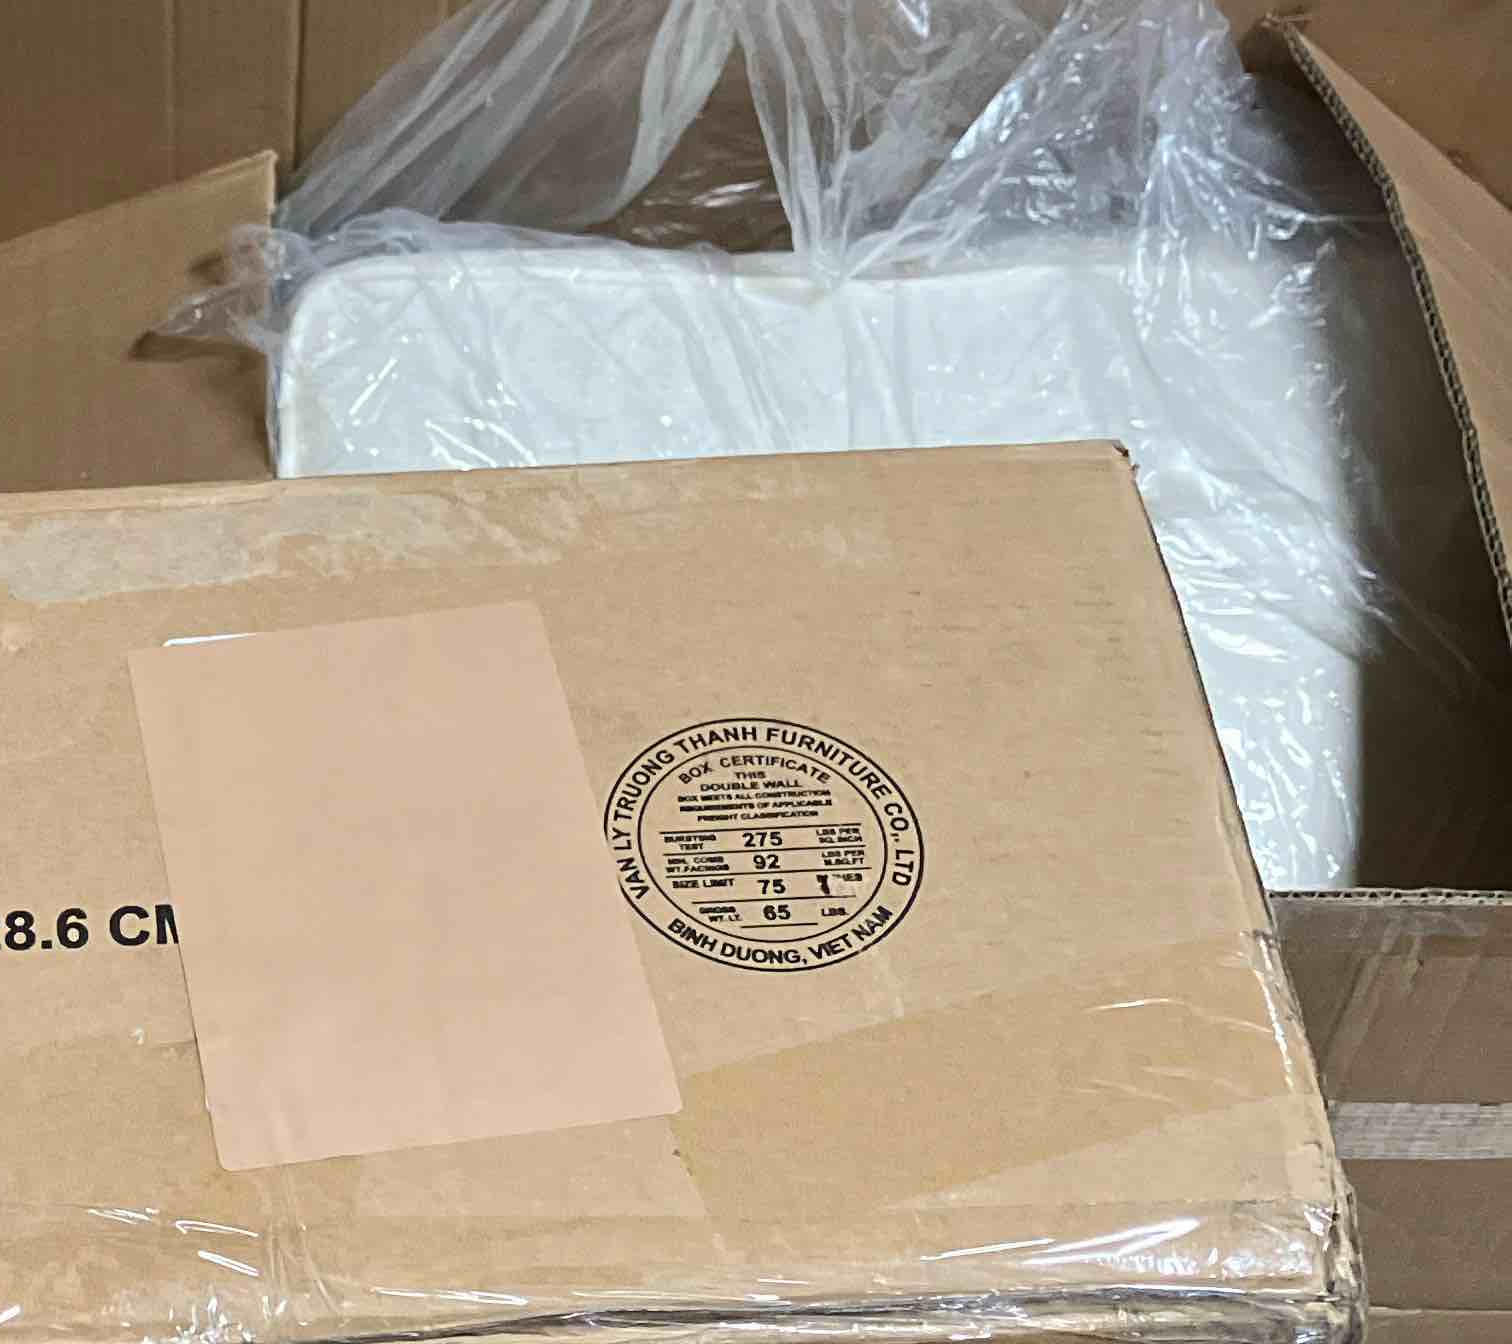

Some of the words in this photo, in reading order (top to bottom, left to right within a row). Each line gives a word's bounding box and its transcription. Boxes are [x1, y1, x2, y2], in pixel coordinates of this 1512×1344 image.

[674, 726, 757, 756] THANH
[678, 761, 713, 785] BOX
[719, 754, 832, 785] CERTIFICATE
[734, 771, 766, 779] THIS
[766, 727, 892, 801] FURNITURE
[613, 748, 676, 823] TRUONG
[700, 781, 760, 792] DOUBLE
[762, 778, 803, 788] WALL
[612, 827, 633, 852] LY
[741, 831, 783, 848] 275
[752, 854, 781, 870] 92
[892, 848, 915, 888] LTD
[616, 856, 651, 901] VAN
[672, 879, 700, 889] SIZE
[703, 878, 735, 888] LIMIT
[757, 878, 786, 895] 75
[762, 905, 791, 921] 65
[668, 917, 718, 952] BINH
[720, 940, 808, 965] DUONG,
[807, 932, 853, 960] VIET
[854, 905, 894, 940] NAM
